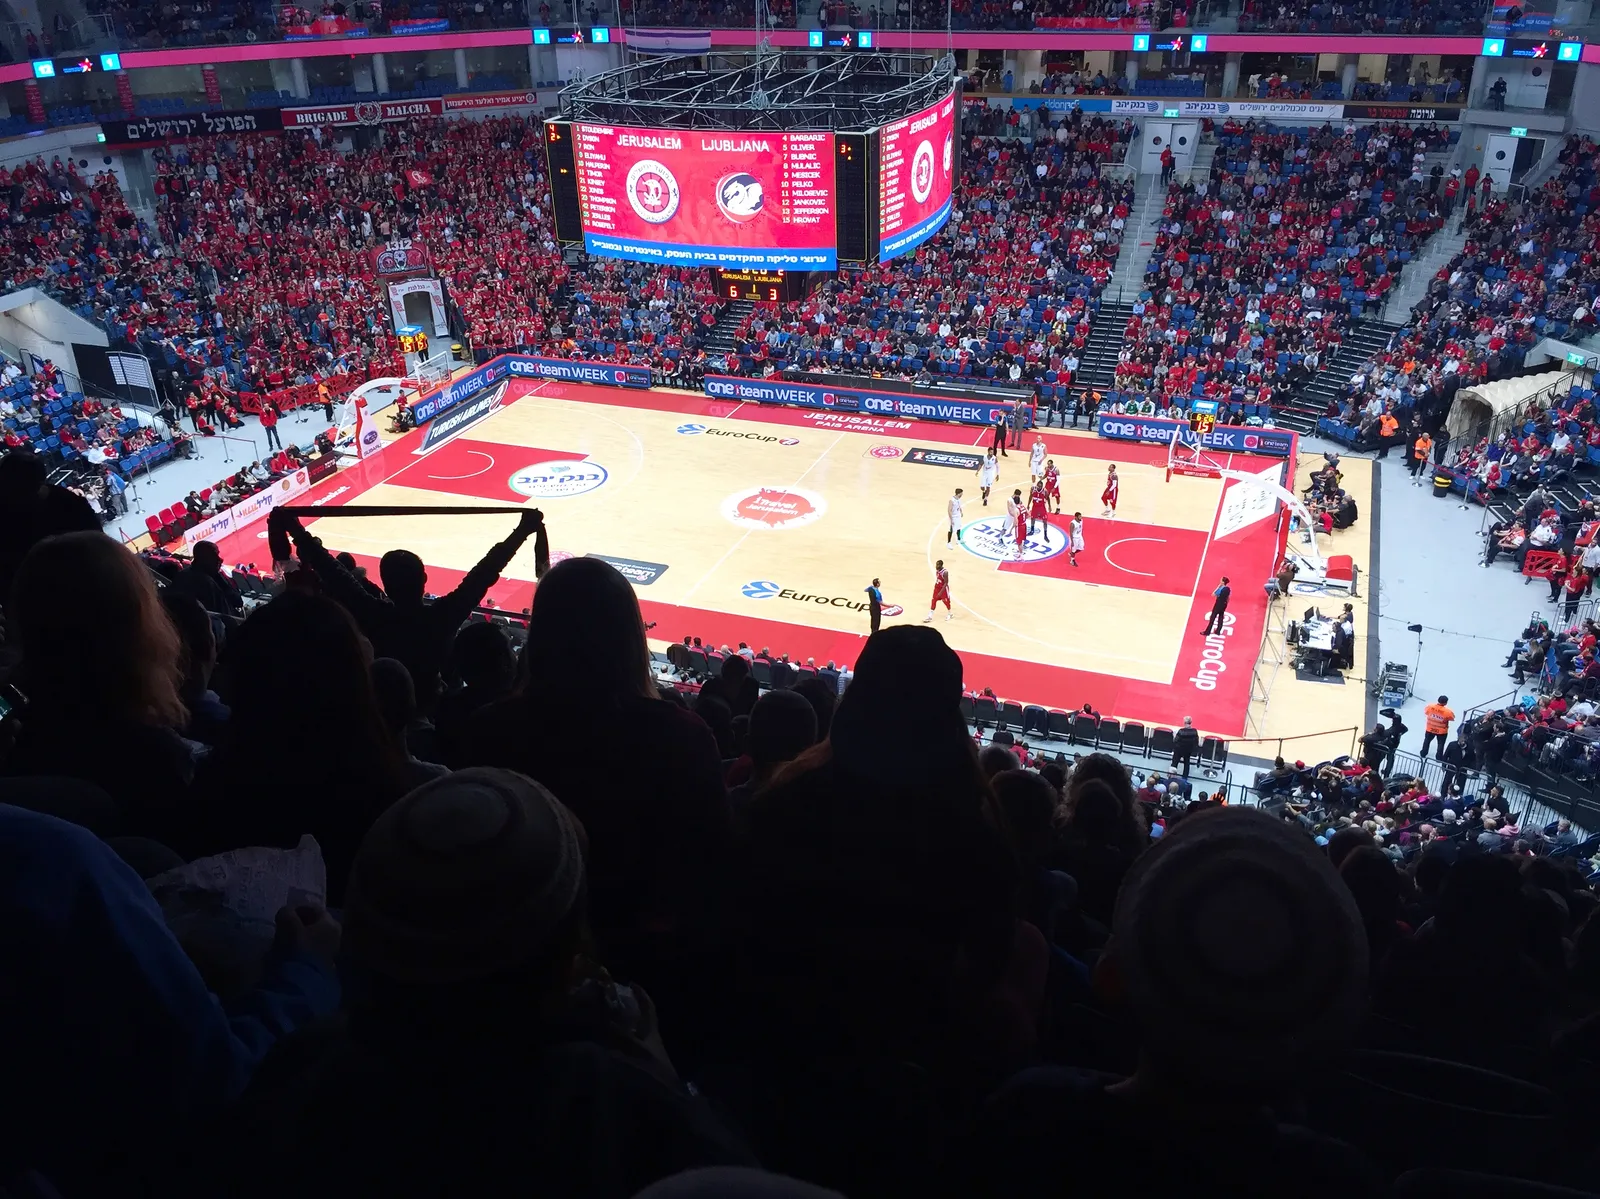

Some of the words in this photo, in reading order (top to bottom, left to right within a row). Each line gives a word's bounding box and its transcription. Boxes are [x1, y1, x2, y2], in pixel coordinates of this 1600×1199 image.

[386, 103, 431, 116] MALCHA
[1130, 101, 1145, 109] בנק
[1185, 102, 1200, 110] יהב
[1200, 102, 1216, 110] בנק
[1239, 103, 1268, 112] ירושלים
[296, 111, 348, 124] BRIGADE
[1410, 108, 1436, 119] ארומה
[127, 117, 197, 139] ירושלים
[201, 112, 257, 133] הפועל
[581, 126, 614, 135] STOUDEMIRE
[617, 135, 682, 150] JERUSALEM
[790, 134, 826, 142] BARBARIC
[583, 143, 595, 151] RON
[701, 139, 770, 153] LJUBLJANA
[841, 144, 846, 153] 3
[584, 152, 606, 161] ELIYAHU
[585, 161, 611, 170] HALPERIN
[586, 169, 603, 178] TIMOR
[792, 189, 828, 197] MILOSEVIC
[589, 195, 617, 205] THOMPSON
[793, 207, 829, 215] JEFFERSON
[385, 239, 413, 251] 1312
[591, 238, 622, 252] ובמובייל
[623, 244, 663, 257] באינטרנט
[694, 251, 717, 261] בבית
[718, 253, 765, 263] מתקדמים
[767, 254, 798, 264] סליקה
[800, 255, 827, 263] ערוצי
[721, 273, 751, 281] JERUSALEM
[729, 285, 738, 298] 6
[752, 284, 756, 293] 1
[769, 288, 777, 301] 3
[403, 342, 412, 351] 15
[509, 360, 535, 373] one
[540, 361, 571, 380] team
[571, 367, 609, 381] WEEK
[416, 401, 435, 420] one
[437, 390, 460, 409] team
[459, 375, 484, 397] WEEK
[707, 381, 734, 395] one
[740, 385, 774, 400] team
[775, 388, 816, 404] WEEK
[864, 397, 893, 411] one
[899, 402, 937, 416] team
[937, 405, 982, 420] WEEK
[803, 412, 912, 430] JERUSALEM
[1196, 413, 1214, 423] 6:26
[430, 412, 464, 440] TURKISH
[815, 420, 843, 429] PAIS
[843, 423, 885, 433] ARENA
[1198, 421, 1209, 432] 15
[705, 428, 778, 443] EuroCup
[1102, 421, 1134, 436] one
[1141, 424, 1183, 442] team
[1185, 430, 1235, 447] WEEK
[363, 443, 382, 457] SUBARU
[517, 475, 555, 484] יהב
[559, 473, 600, 483] בנק
[745, 503, 799, 516] Jerusalem
[621, 567, 656, 578] team
[778, 589, 871, 613] EuroCup
